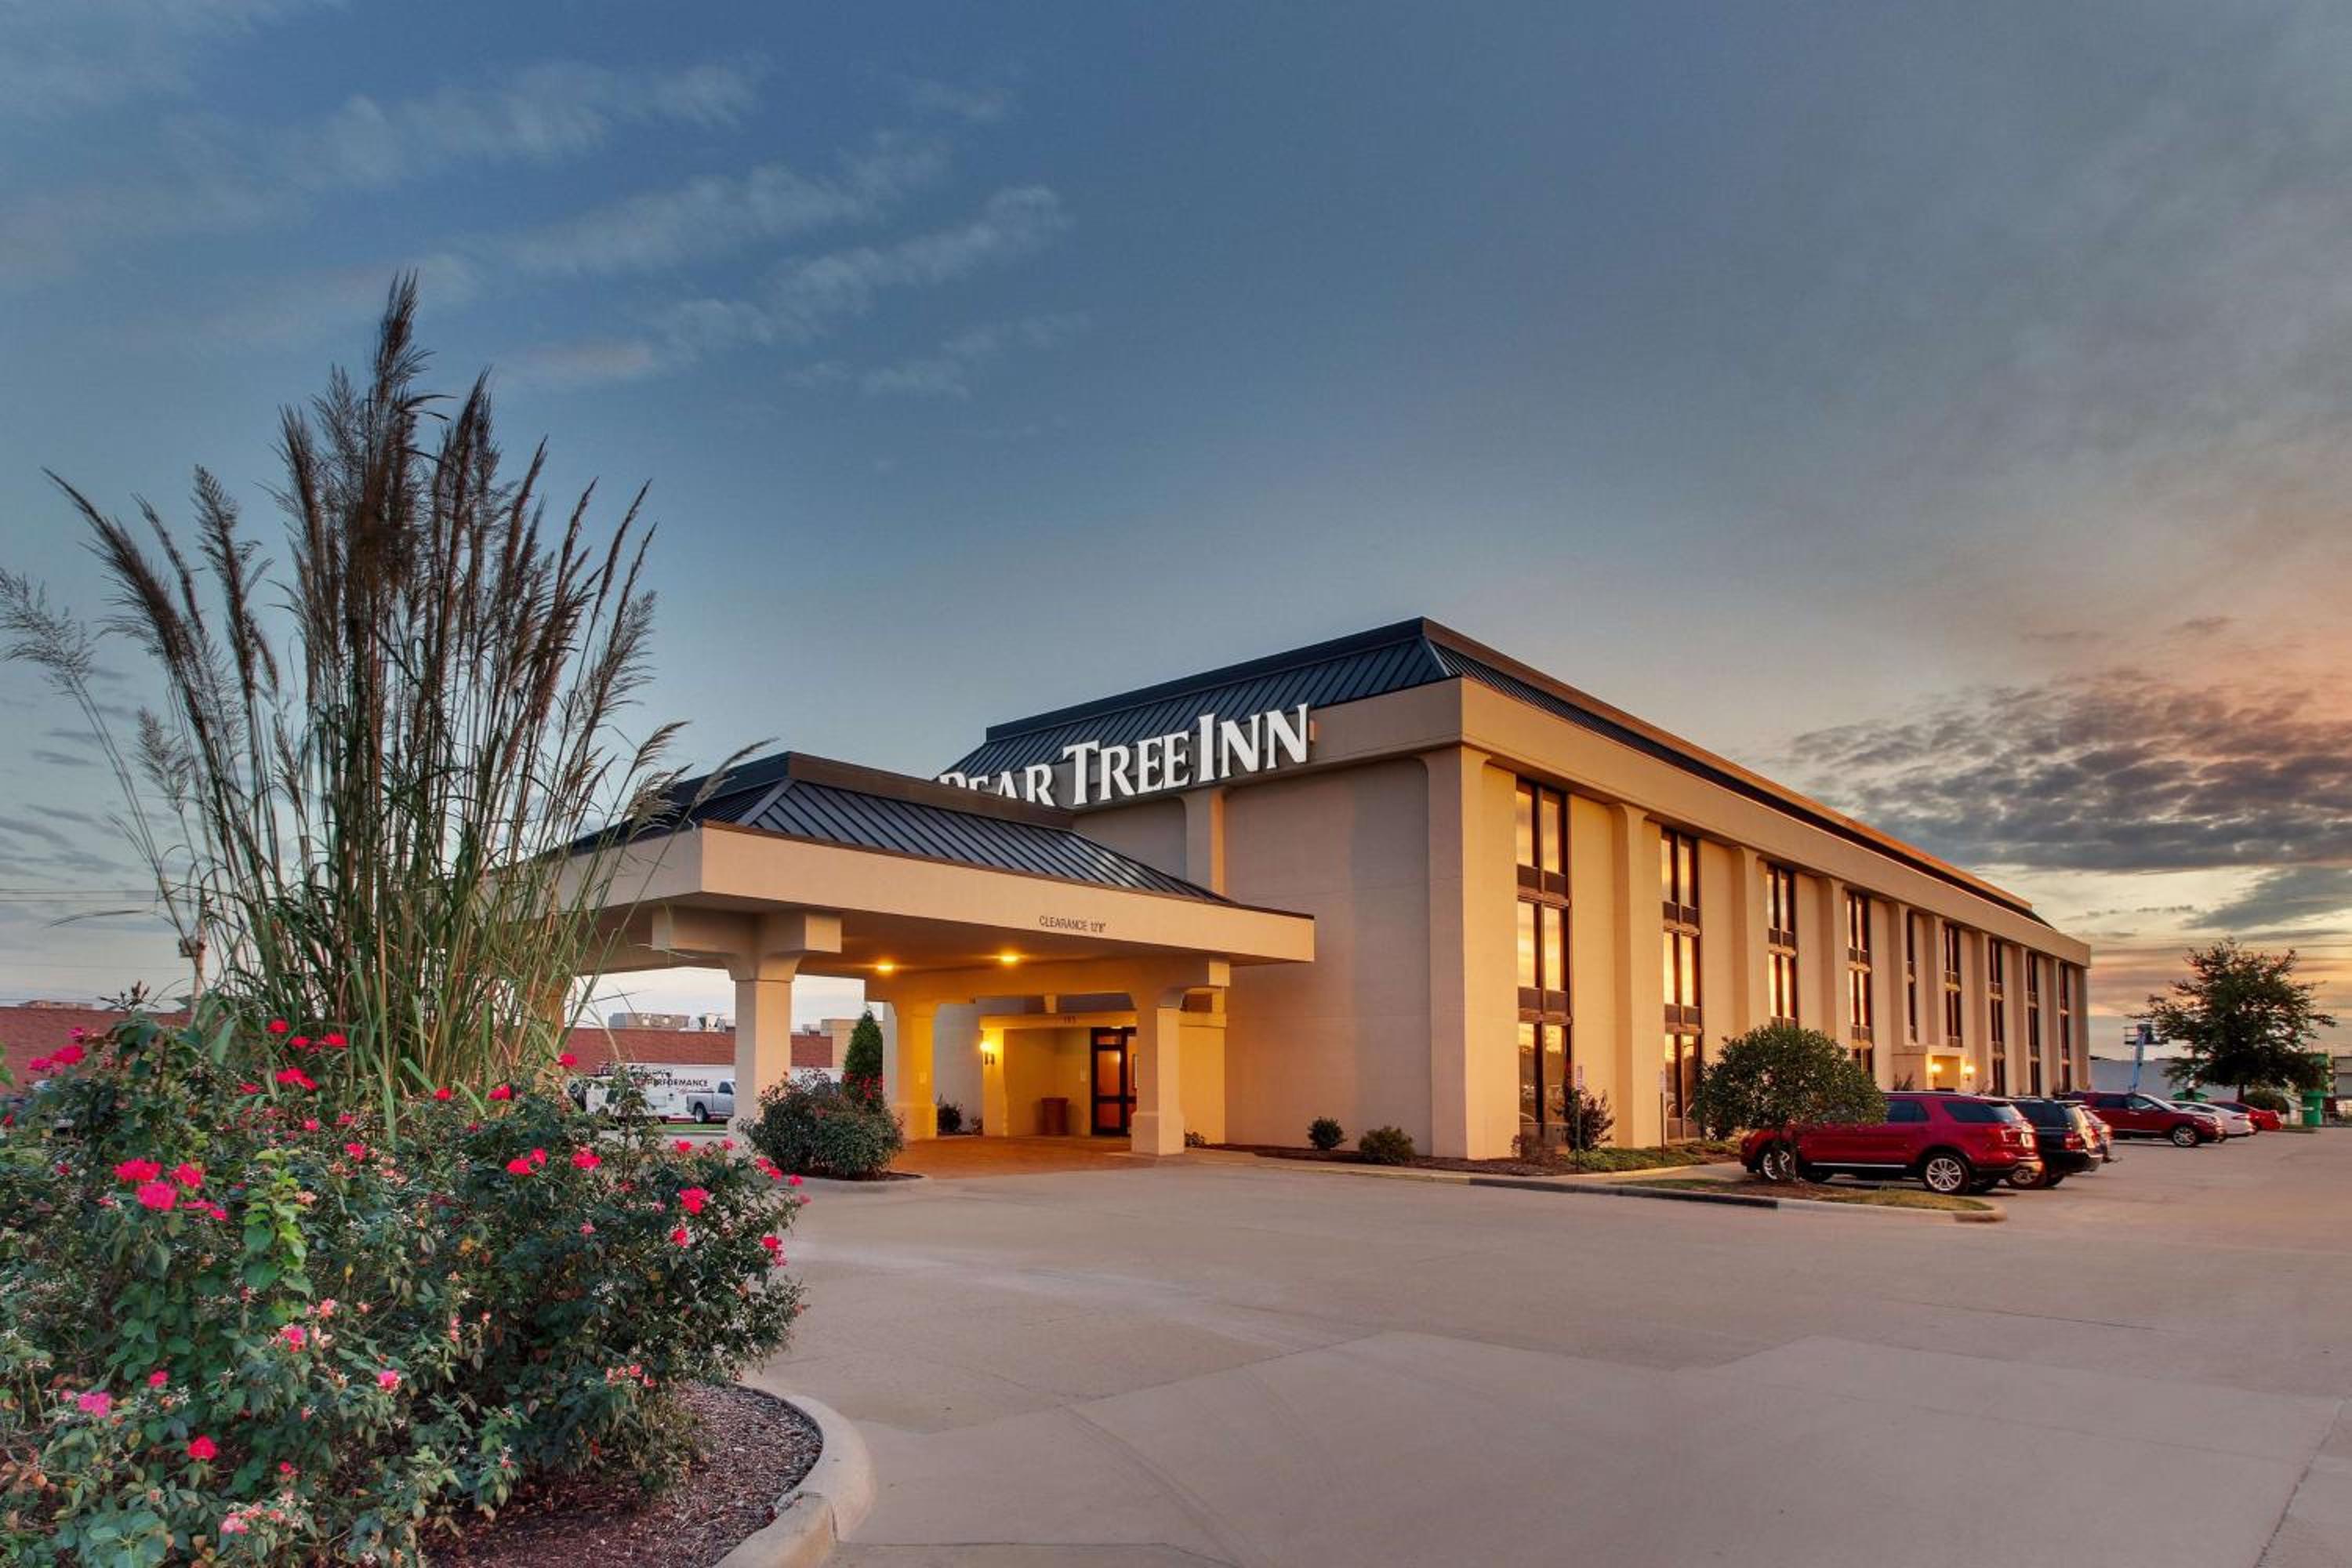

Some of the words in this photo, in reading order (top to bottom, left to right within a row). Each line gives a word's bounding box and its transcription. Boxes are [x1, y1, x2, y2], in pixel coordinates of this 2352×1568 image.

[1063, 730, 1190, 805] TREE
[1199, 703, 1308, 782] INN
[1039, 915, 1087, 931] CLEARANCE
[647, 1078, 708, 1087] PRFORMANCE
